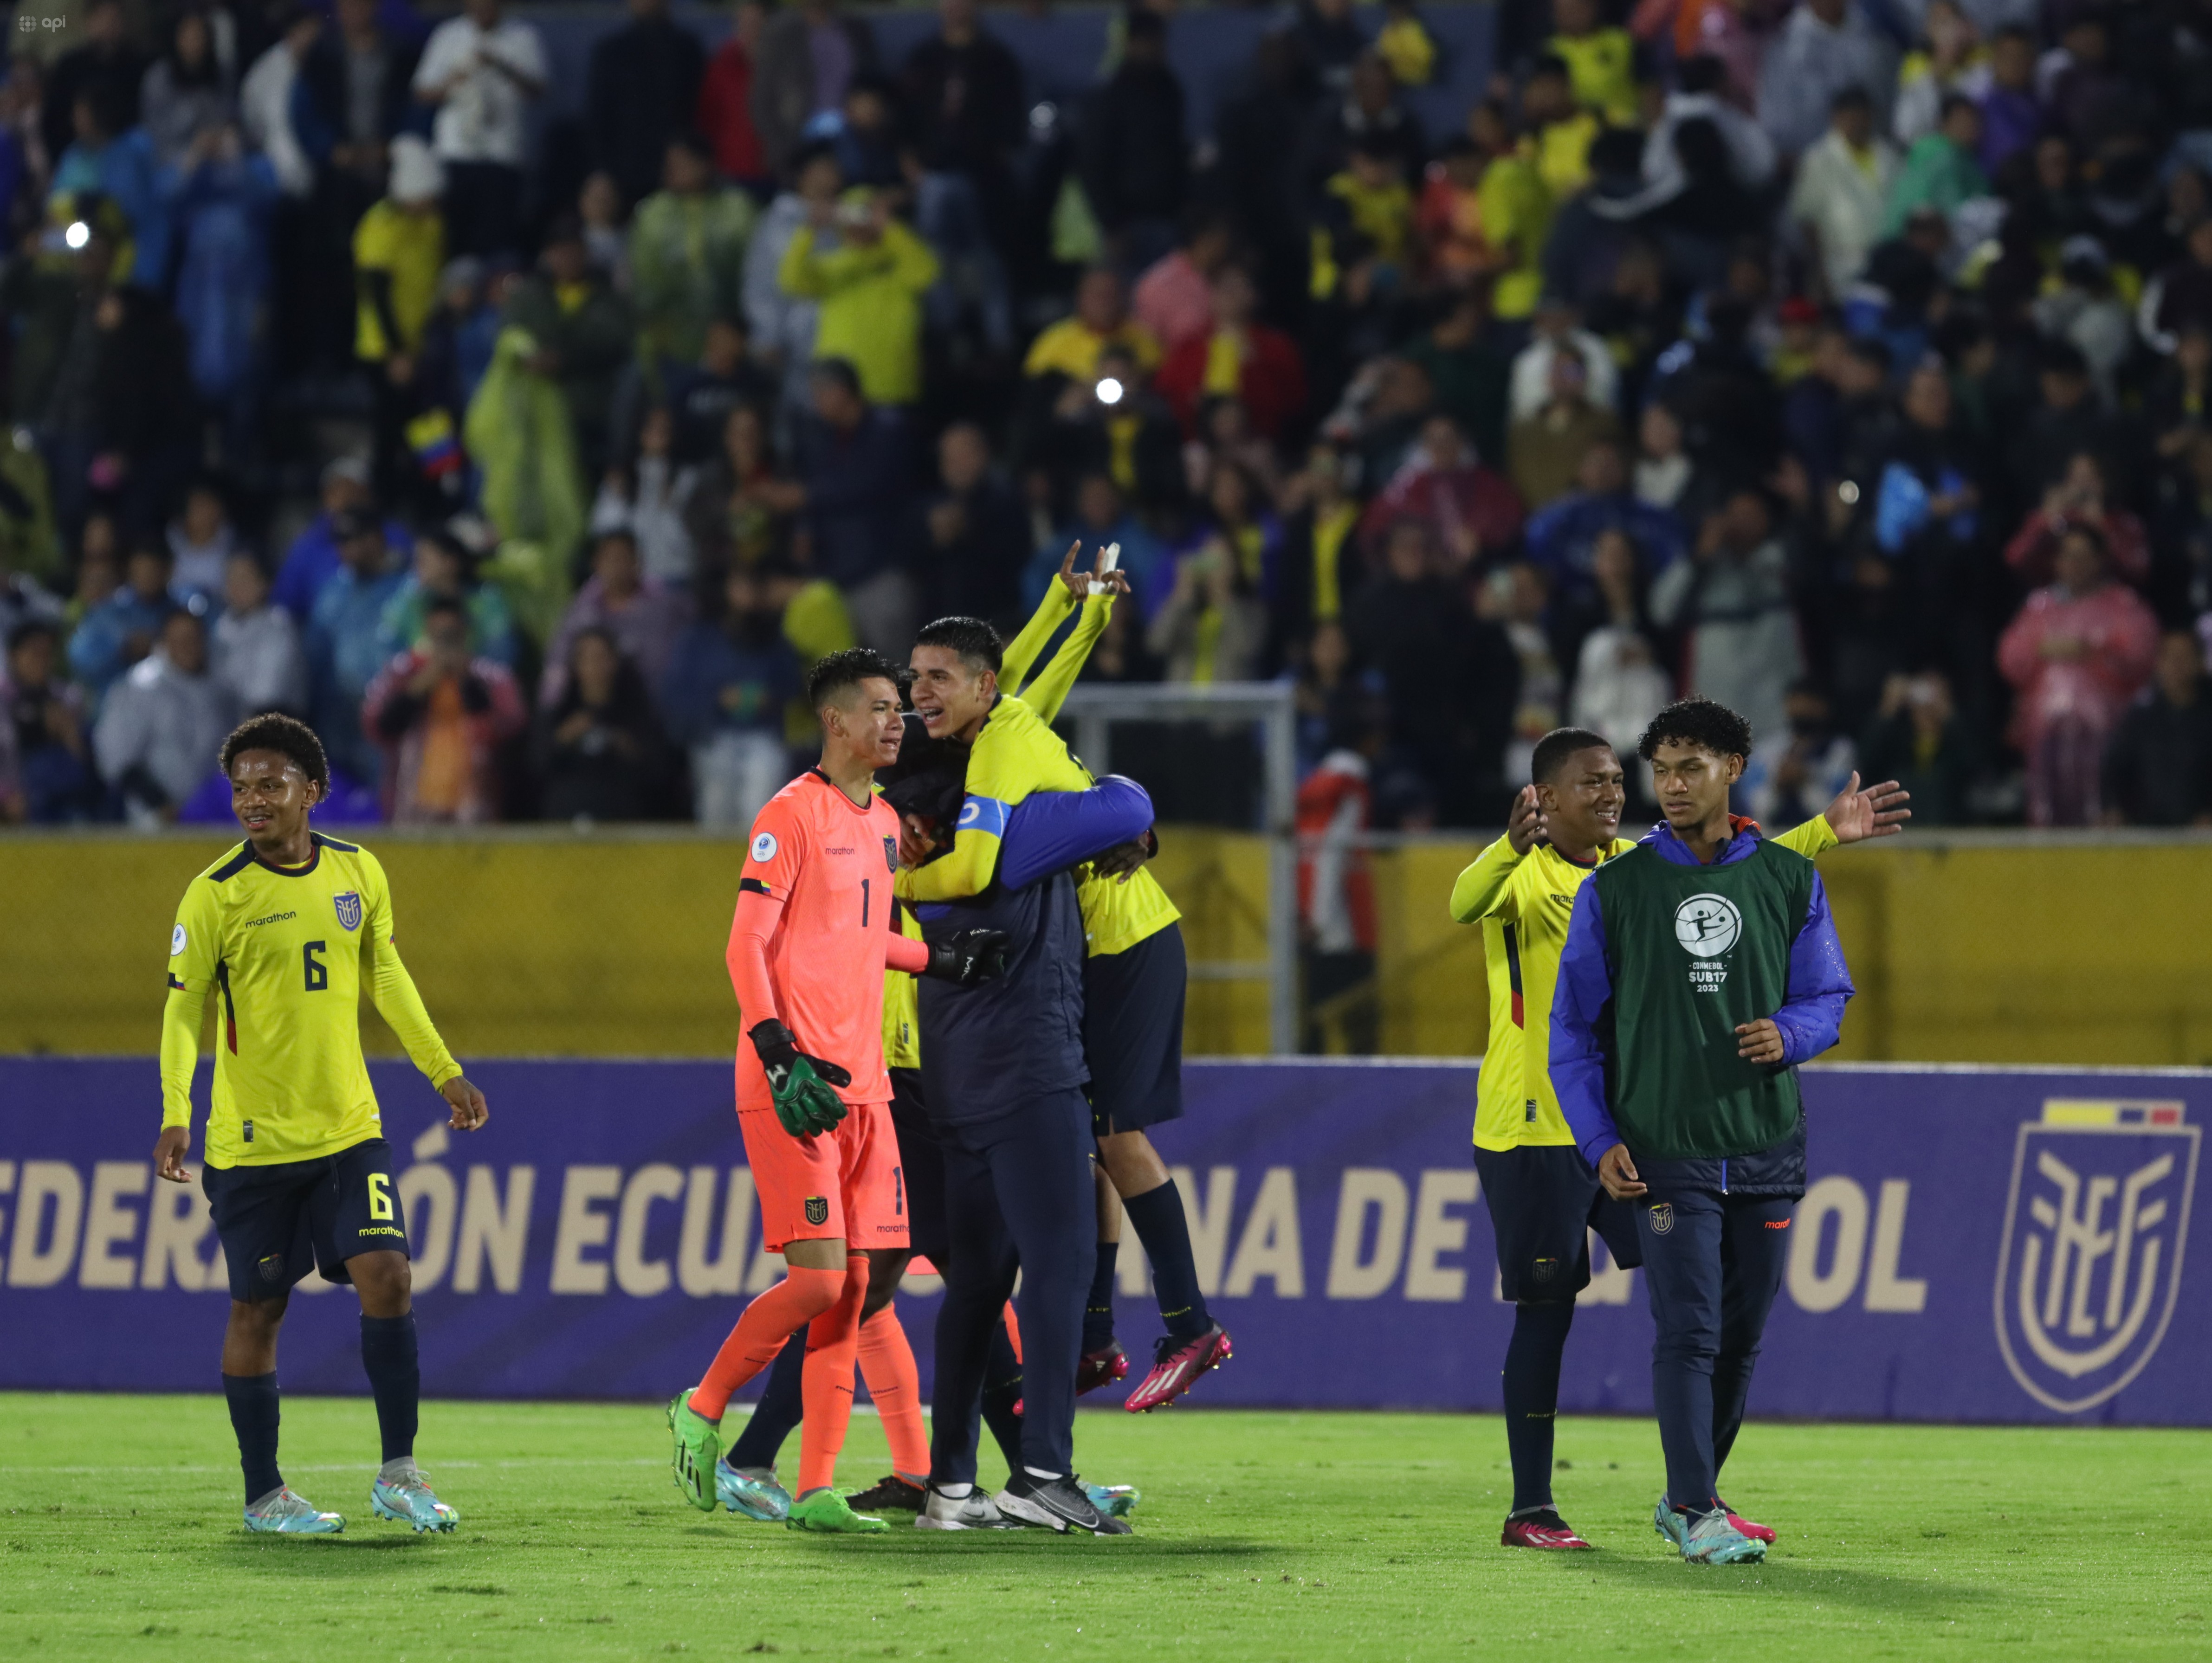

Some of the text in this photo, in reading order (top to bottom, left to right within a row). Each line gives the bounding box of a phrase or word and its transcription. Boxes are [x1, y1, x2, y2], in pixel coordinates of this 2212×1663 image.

[245, 911, 297, 928] marathon
[861, 879, 869, 927] 1
[303, 941, 328, 992] 6
[1688, 972, 1727, 983] SUB17
[368, 1173, 394, 1221] 6
[893, 1167, 902, 1215] 1
[359, 1226, 404, 1239] marathon
[1325, 1165, 1480, 1302] DE
